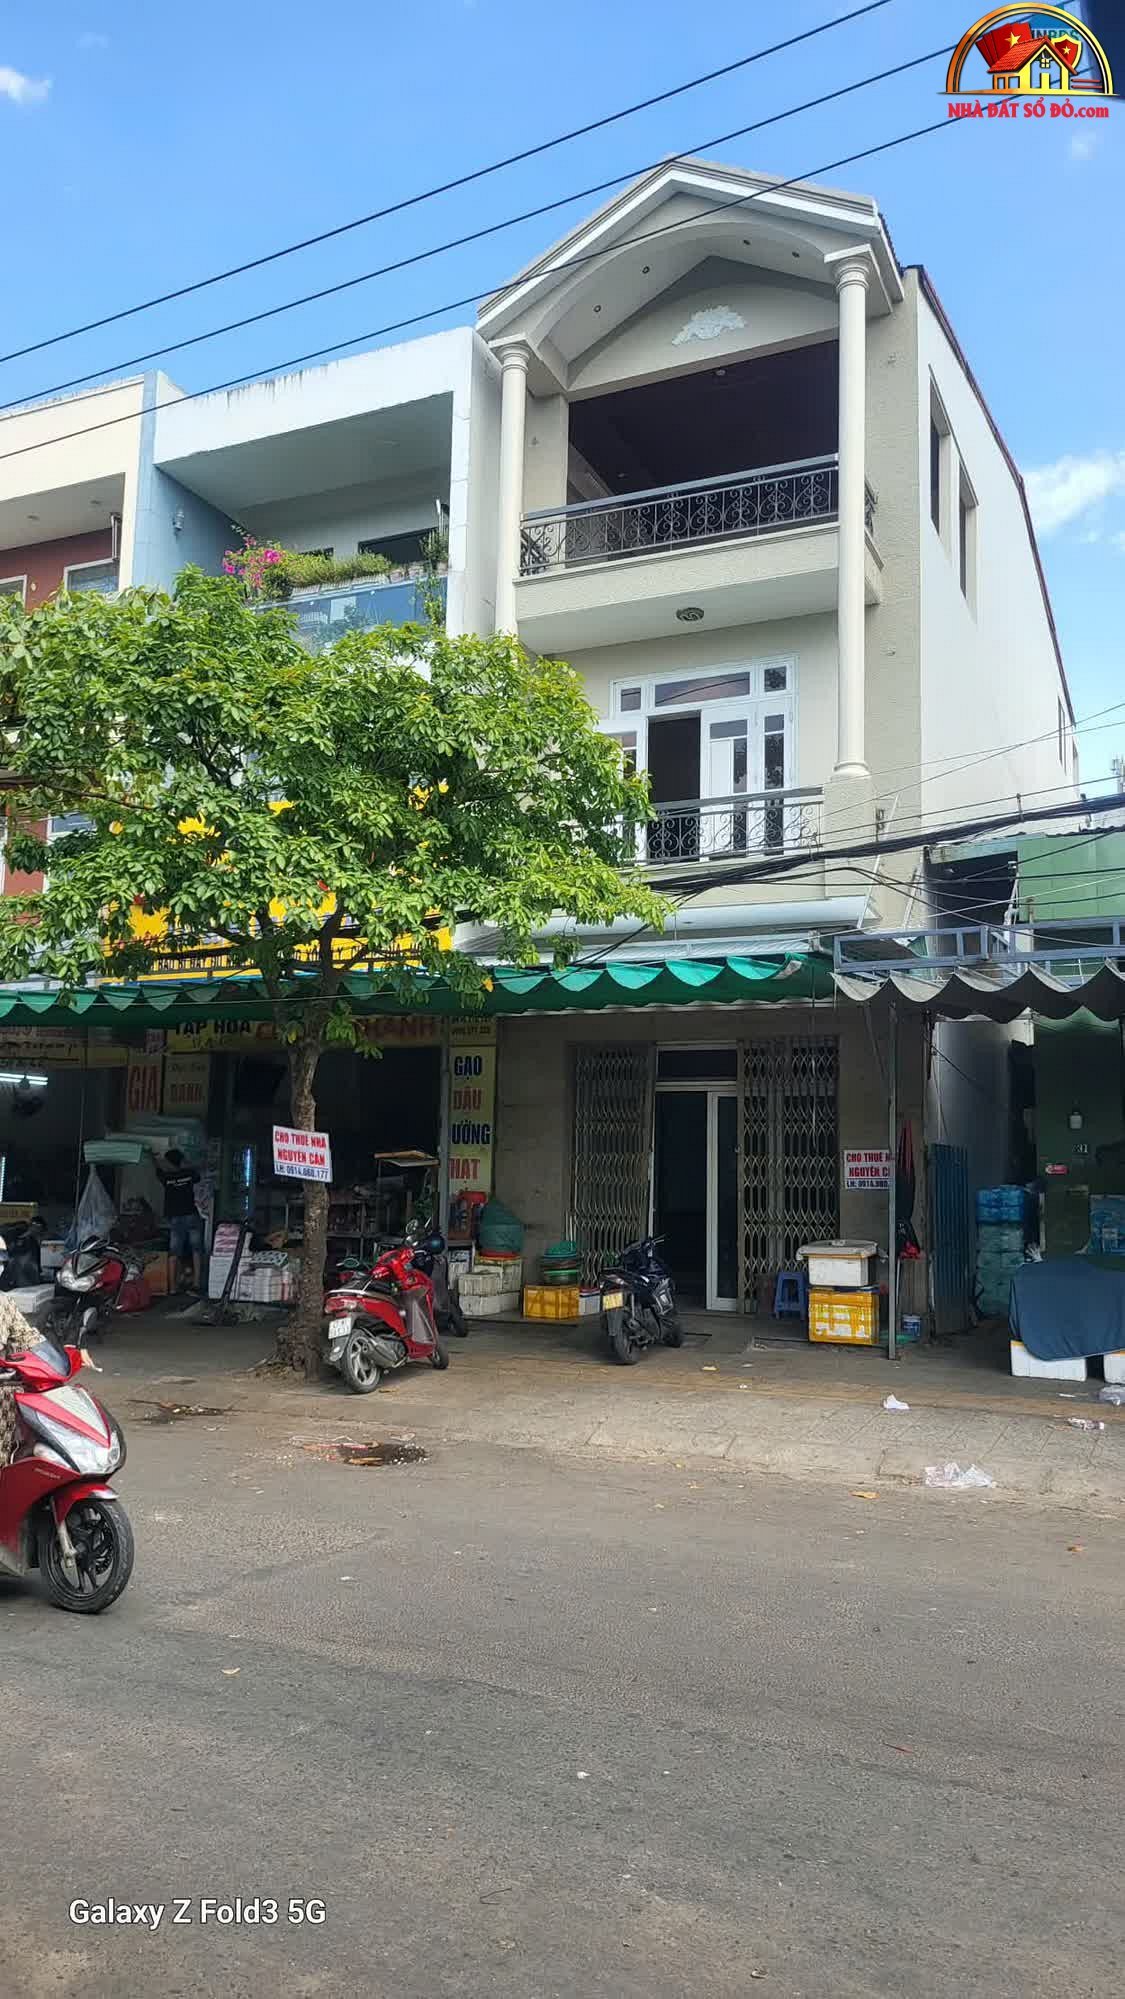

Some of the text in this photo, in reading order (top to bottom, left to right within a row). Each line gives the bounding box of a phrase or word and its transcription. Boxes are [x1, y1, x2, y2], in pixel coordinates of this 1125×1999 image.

[454, 1056, 482, 1080] GẠO
[275, 1131, 289, 1144] CHO
[846, 1152, 862, 1163] CHO
